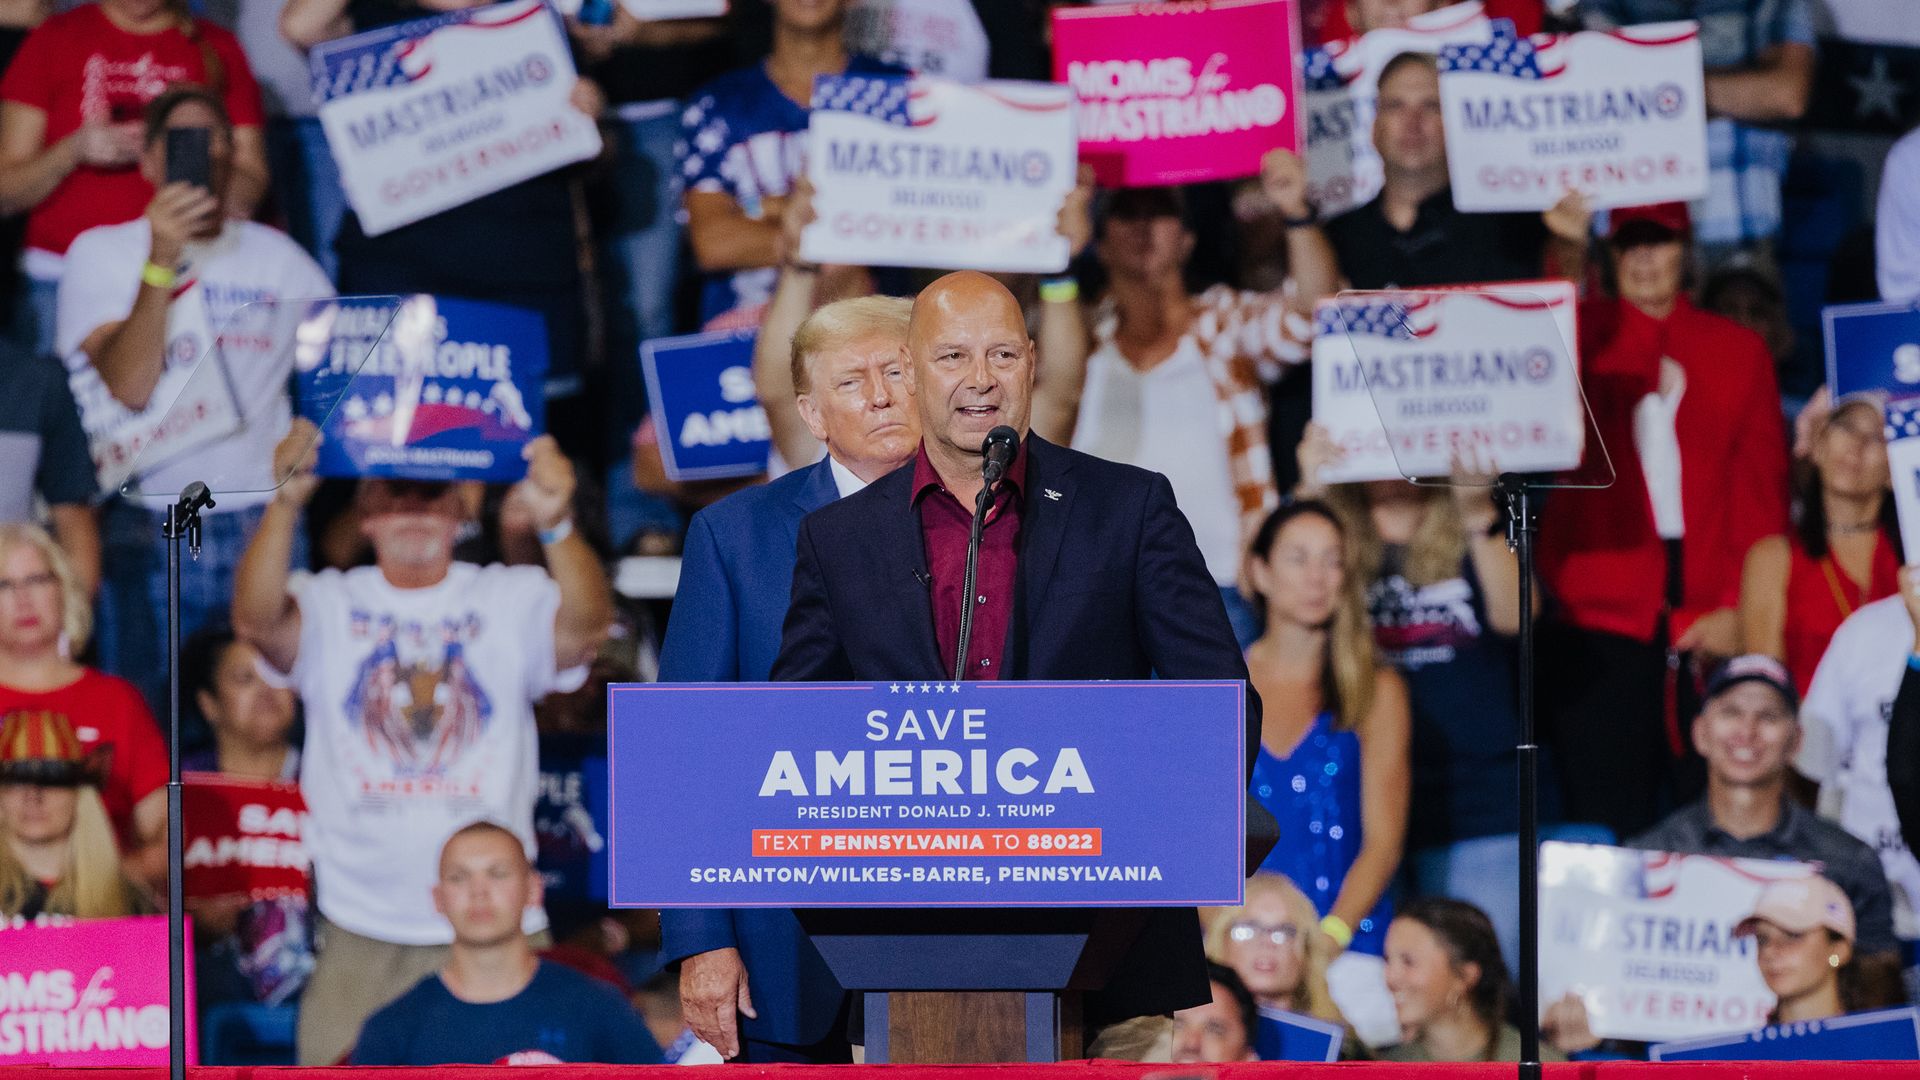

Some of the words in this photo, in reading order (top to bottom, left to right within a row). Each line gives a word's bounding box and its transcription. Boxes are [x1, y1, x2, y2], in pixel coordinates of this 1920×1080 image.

[1068, 57, 1193, 98] MOMS
[1462, 82, 1686, 132] MASTRIANO
[829, 137, 1053, 188] MASTRIANO
[1478, 153, 1682, 193] GOVERNOR
[1331, 346, 1556, 393] MASTRIANO
[866, 708, 987, 741] SAVE
[758, 747, 1095, 797] AMERICA
[797, 805, 892, 819] PRESIDENT
[898, 805, 971, 818] DONALD
[977, 805, 991, 817] J.
[997, 804, 1056, 817] TRUMP
[760, 835, 812, 851] TEXT
[820, 834, 985, 850] PENNSYLVANIA
[992, 834, 1020, 850] TO
[1027, 834, 1093, 850] 88022
[690, 865, 991, 885] SCRANTON/WILKES-BARRE,
[998, 865, 1163, 882] PENNSYLVANIA
